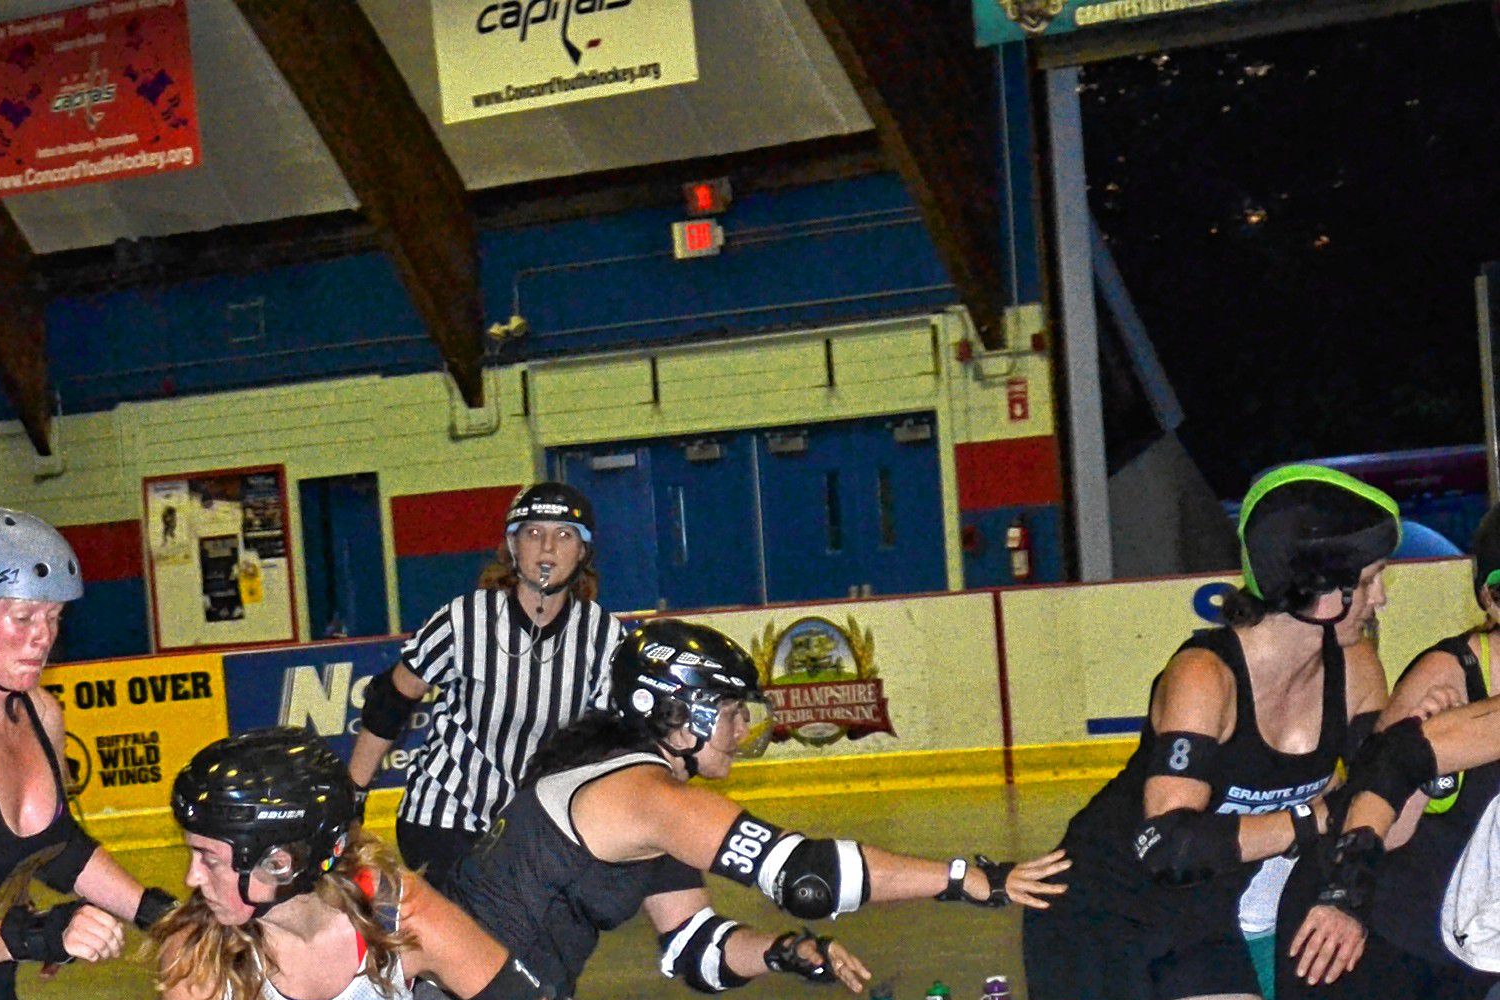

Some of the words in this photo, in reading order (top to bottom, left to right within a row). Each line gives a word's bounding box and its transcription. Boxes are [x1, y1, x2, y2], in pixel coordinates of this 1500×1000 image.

[472, 62, 661, 107] www.ConcordYouthHockey.org
[75, 680, 117, 709] ON
[128, 671, 213, 704] OVER
[788, 682, 878, 707] HAMPSHIRE
[97, 731, 160, 748] BUFFALO
[98, 745, 161, 769] WILD
[1169, 738, 1191, 771] 8
[100, 766, 162, 788] WINGS
[1228, 786, 1293, 801] GRANITE
[720, 820, 773, 873] 369
